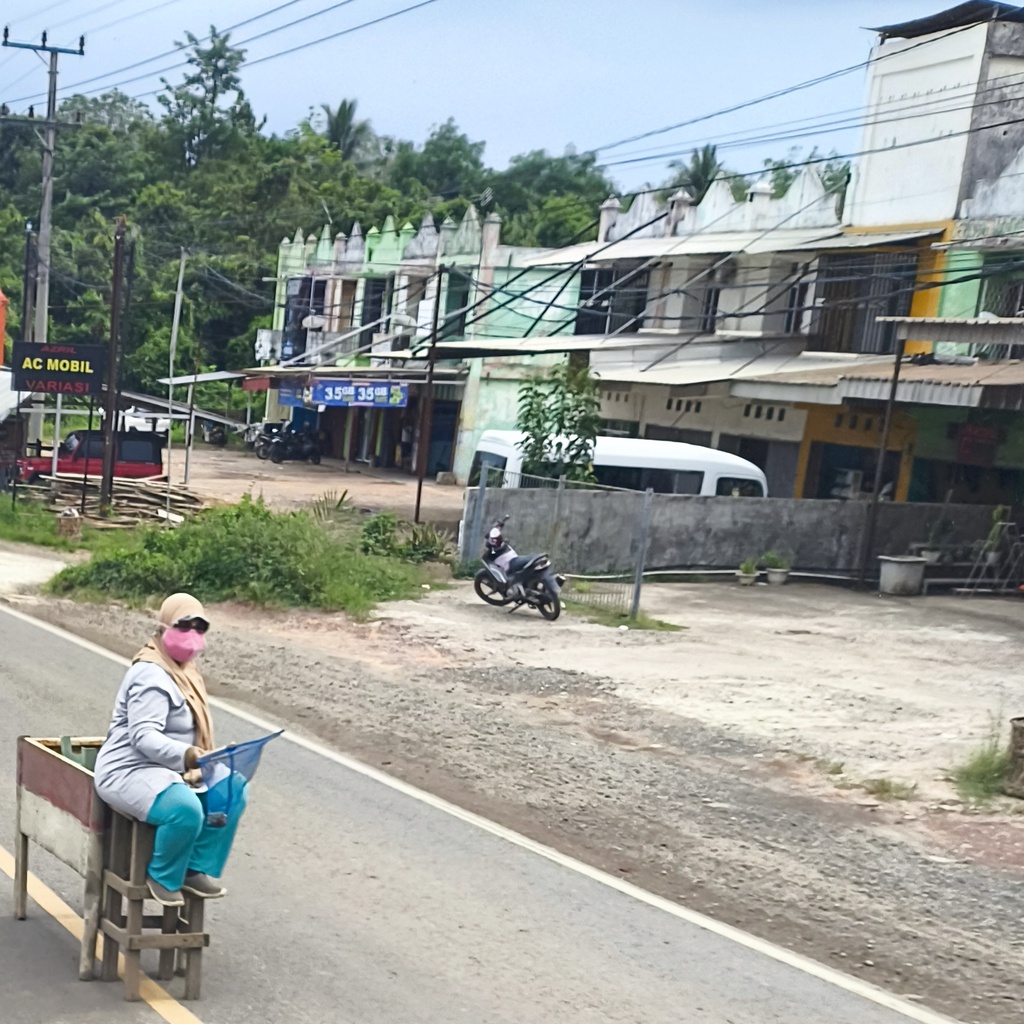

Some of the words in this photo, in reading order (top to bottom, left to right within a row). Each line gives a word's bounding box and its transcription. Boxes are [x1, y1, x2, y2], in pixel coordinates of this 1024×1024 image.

[22, 357, 43, 370] AC
[46, 358, 94, 374] MOBIL
[25, 380, 90, 393] VARIASI
